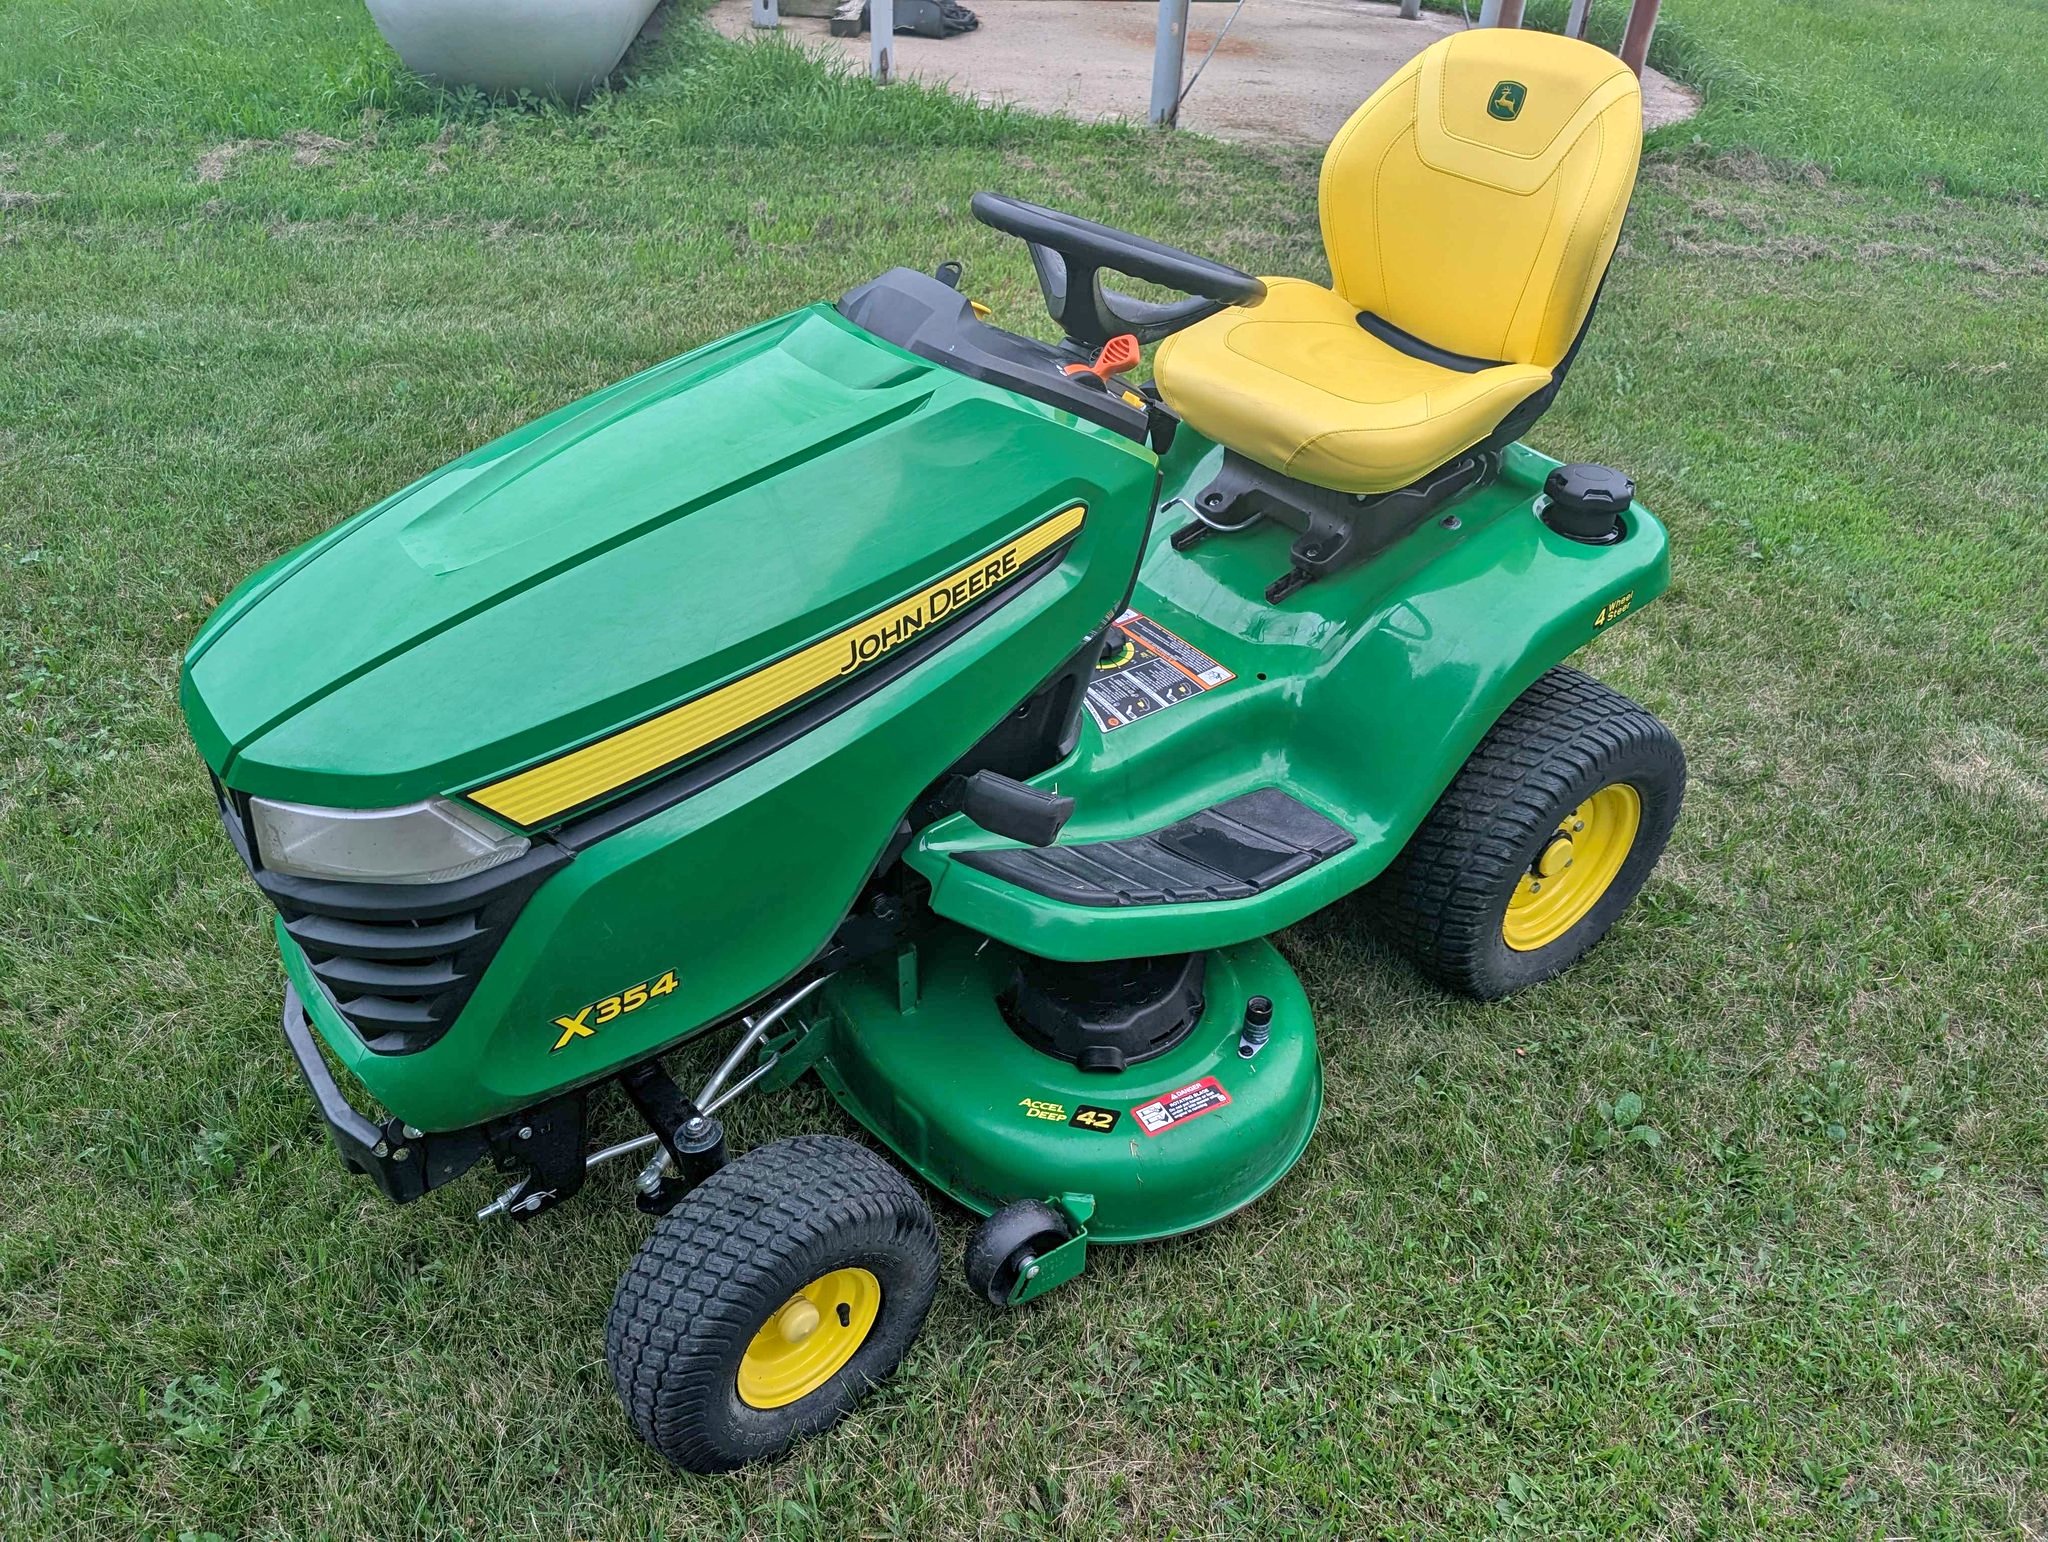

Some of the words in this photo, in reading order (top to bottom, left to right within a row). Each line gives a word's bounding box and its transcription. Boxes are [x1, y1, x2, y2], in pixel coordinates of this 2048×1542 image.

[840, 605, 924, 674] JOHN
[928, 547, 1019, 620] DEERE
[1593, 607, 1607, 626] 4
[1608, 590, 1634, 612] Wheel
[1606, 601, 1632, 622] Steer
[552, 970, 680, 1051] X354
[1176, 1083, 1202, 1096] DANGER
[1018, 1097, 1065, 1114] ACCEL
[1169, 1094, 1194, 1107] ROTATING
[1026, 1106, 1068, 1122] DEEP
[1075, 1110, 1114, 1130] 42
